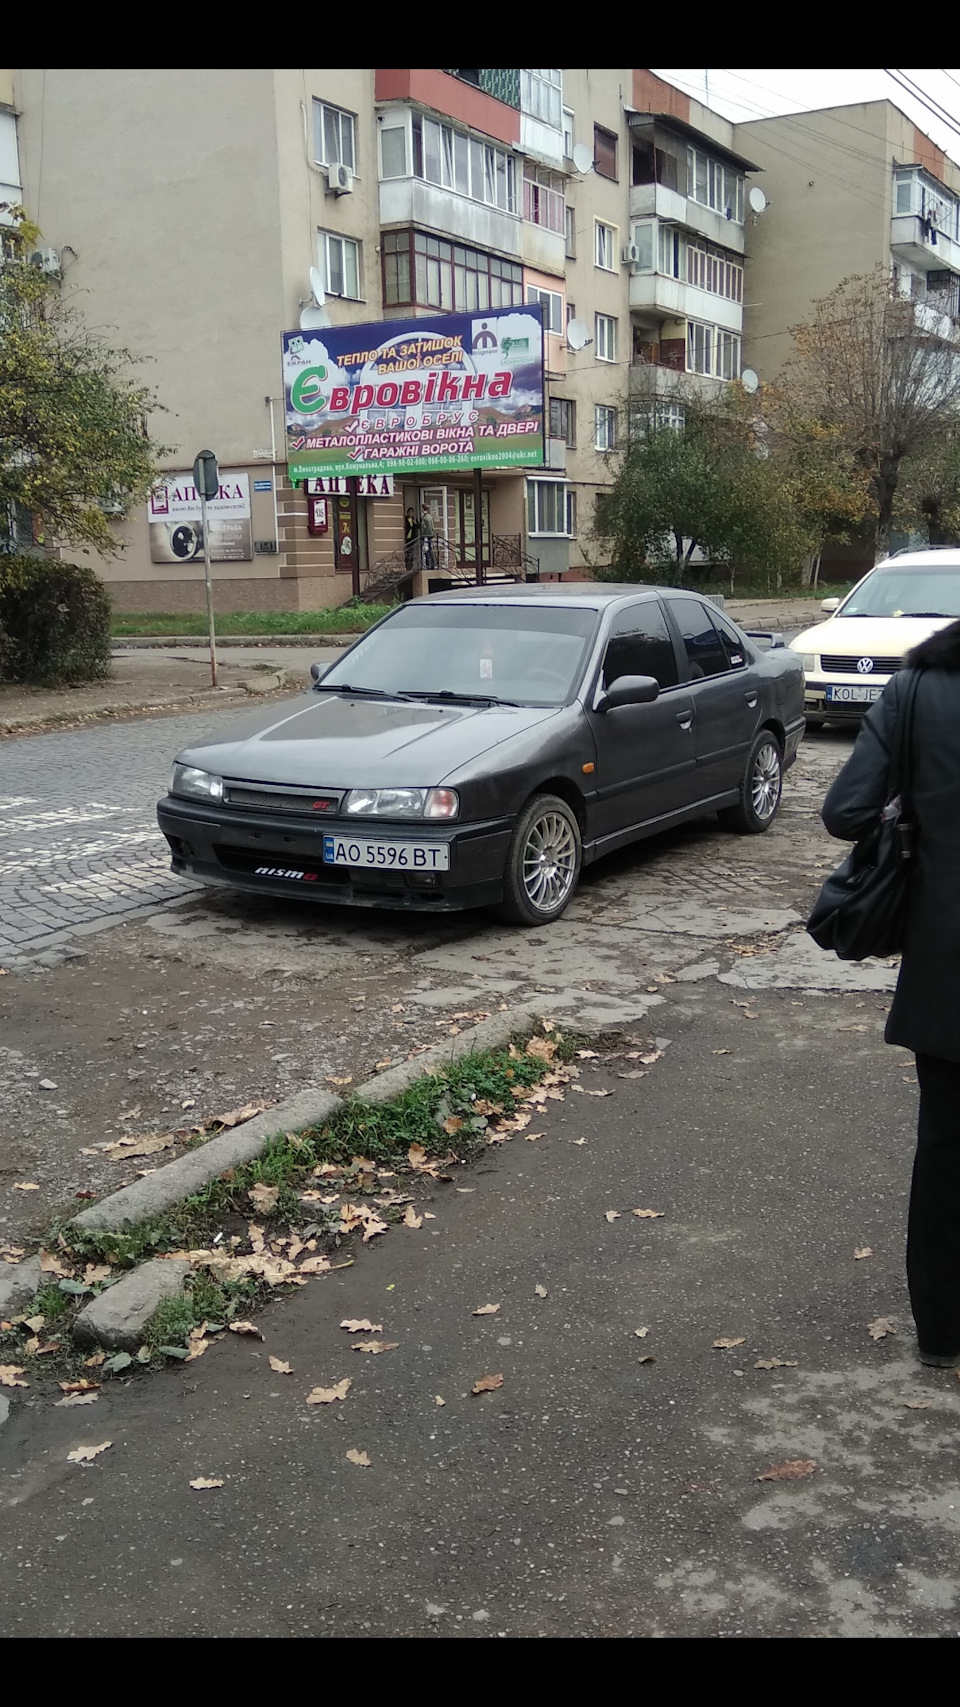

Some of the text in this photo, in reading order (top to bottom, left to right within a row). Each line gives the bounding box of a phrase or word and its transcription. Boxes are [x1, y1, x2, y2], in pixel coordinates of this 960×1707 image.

[336, 335, 463, 367] ТЕПЛО ТА ЗАТИШОК
[377, 351, 464, 375] ВАШОЇ ОСЕЛІ
[290, 364, 514, 416] Євровікна
[305, 421, 539, 449] МЕТАЛОПЛАСТИКОВІ ВІКНА ТА ДВЕРІ
[363, 441, 474, 460] ГАРАЖНІ ВОРОТА
[172, 484, 244, 502] АПКА
[335, 842, 441, 868] AO 5596 BT
[254, 866, 319, 881] nismo
